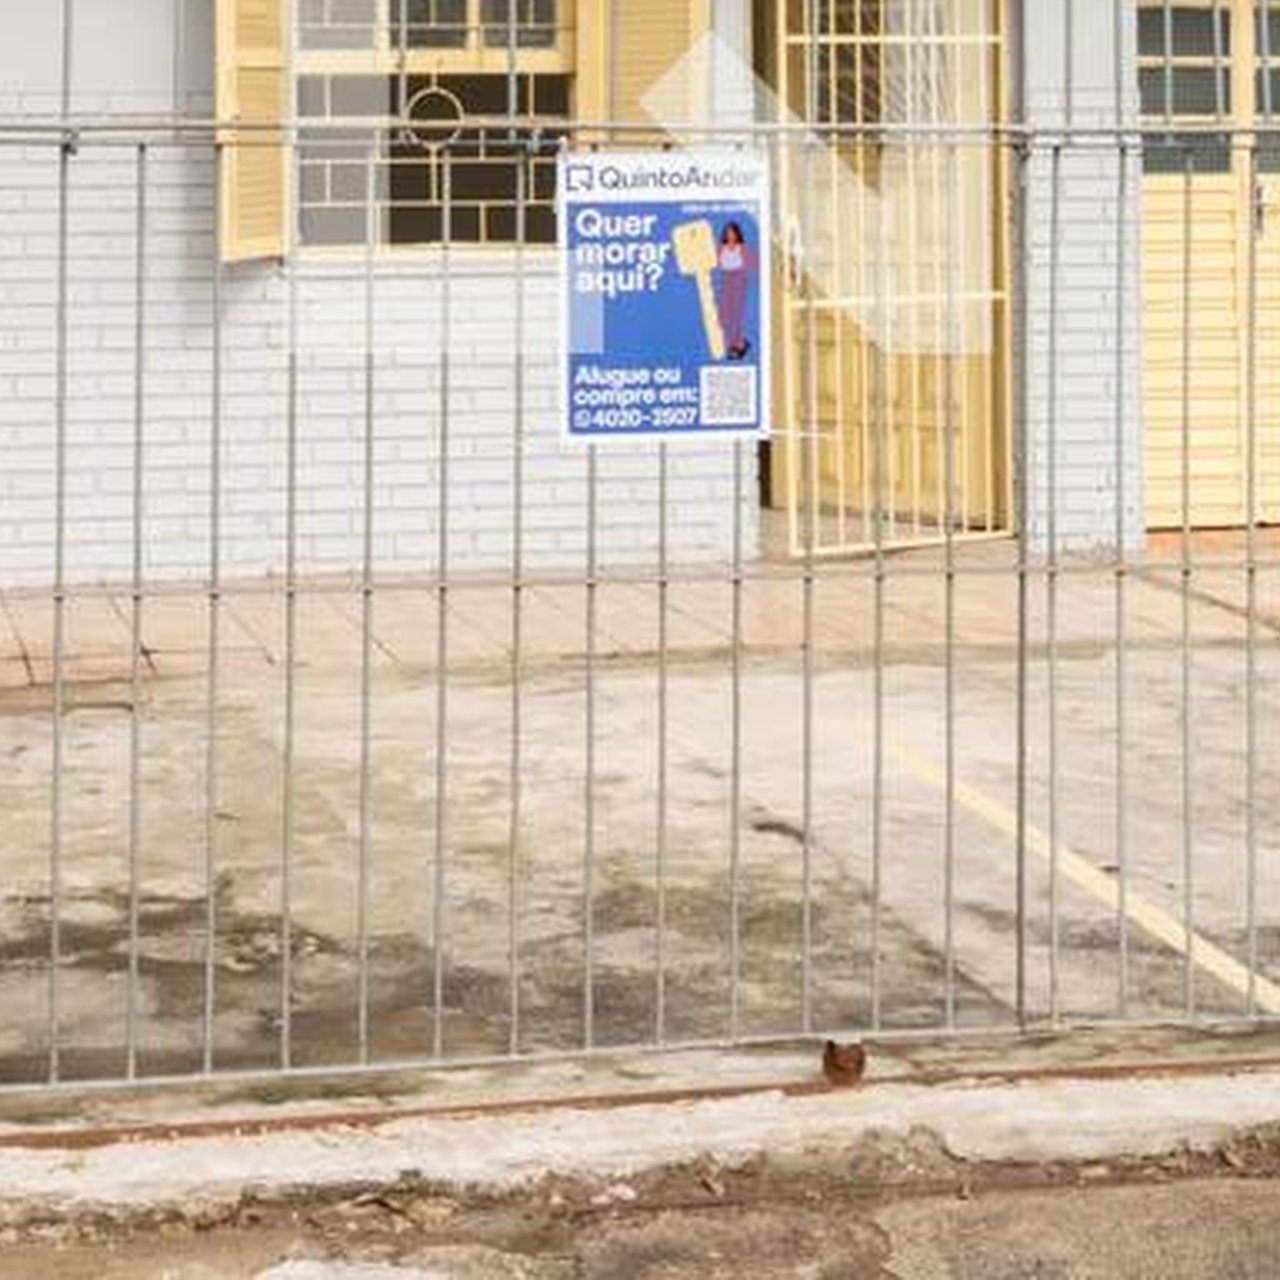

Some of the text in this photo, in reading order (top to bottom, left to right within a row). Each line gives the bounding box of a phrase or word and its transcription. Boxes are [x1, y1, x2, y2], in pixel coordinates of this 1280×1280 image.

[576, 208, 658, 237] Quer
[577, 242, 670, 264] morar
[577, 264, 664, 298] aqui?
[575, 366, 681, 388] Alugue ou
[573, 387, 698, 410] compre em:
